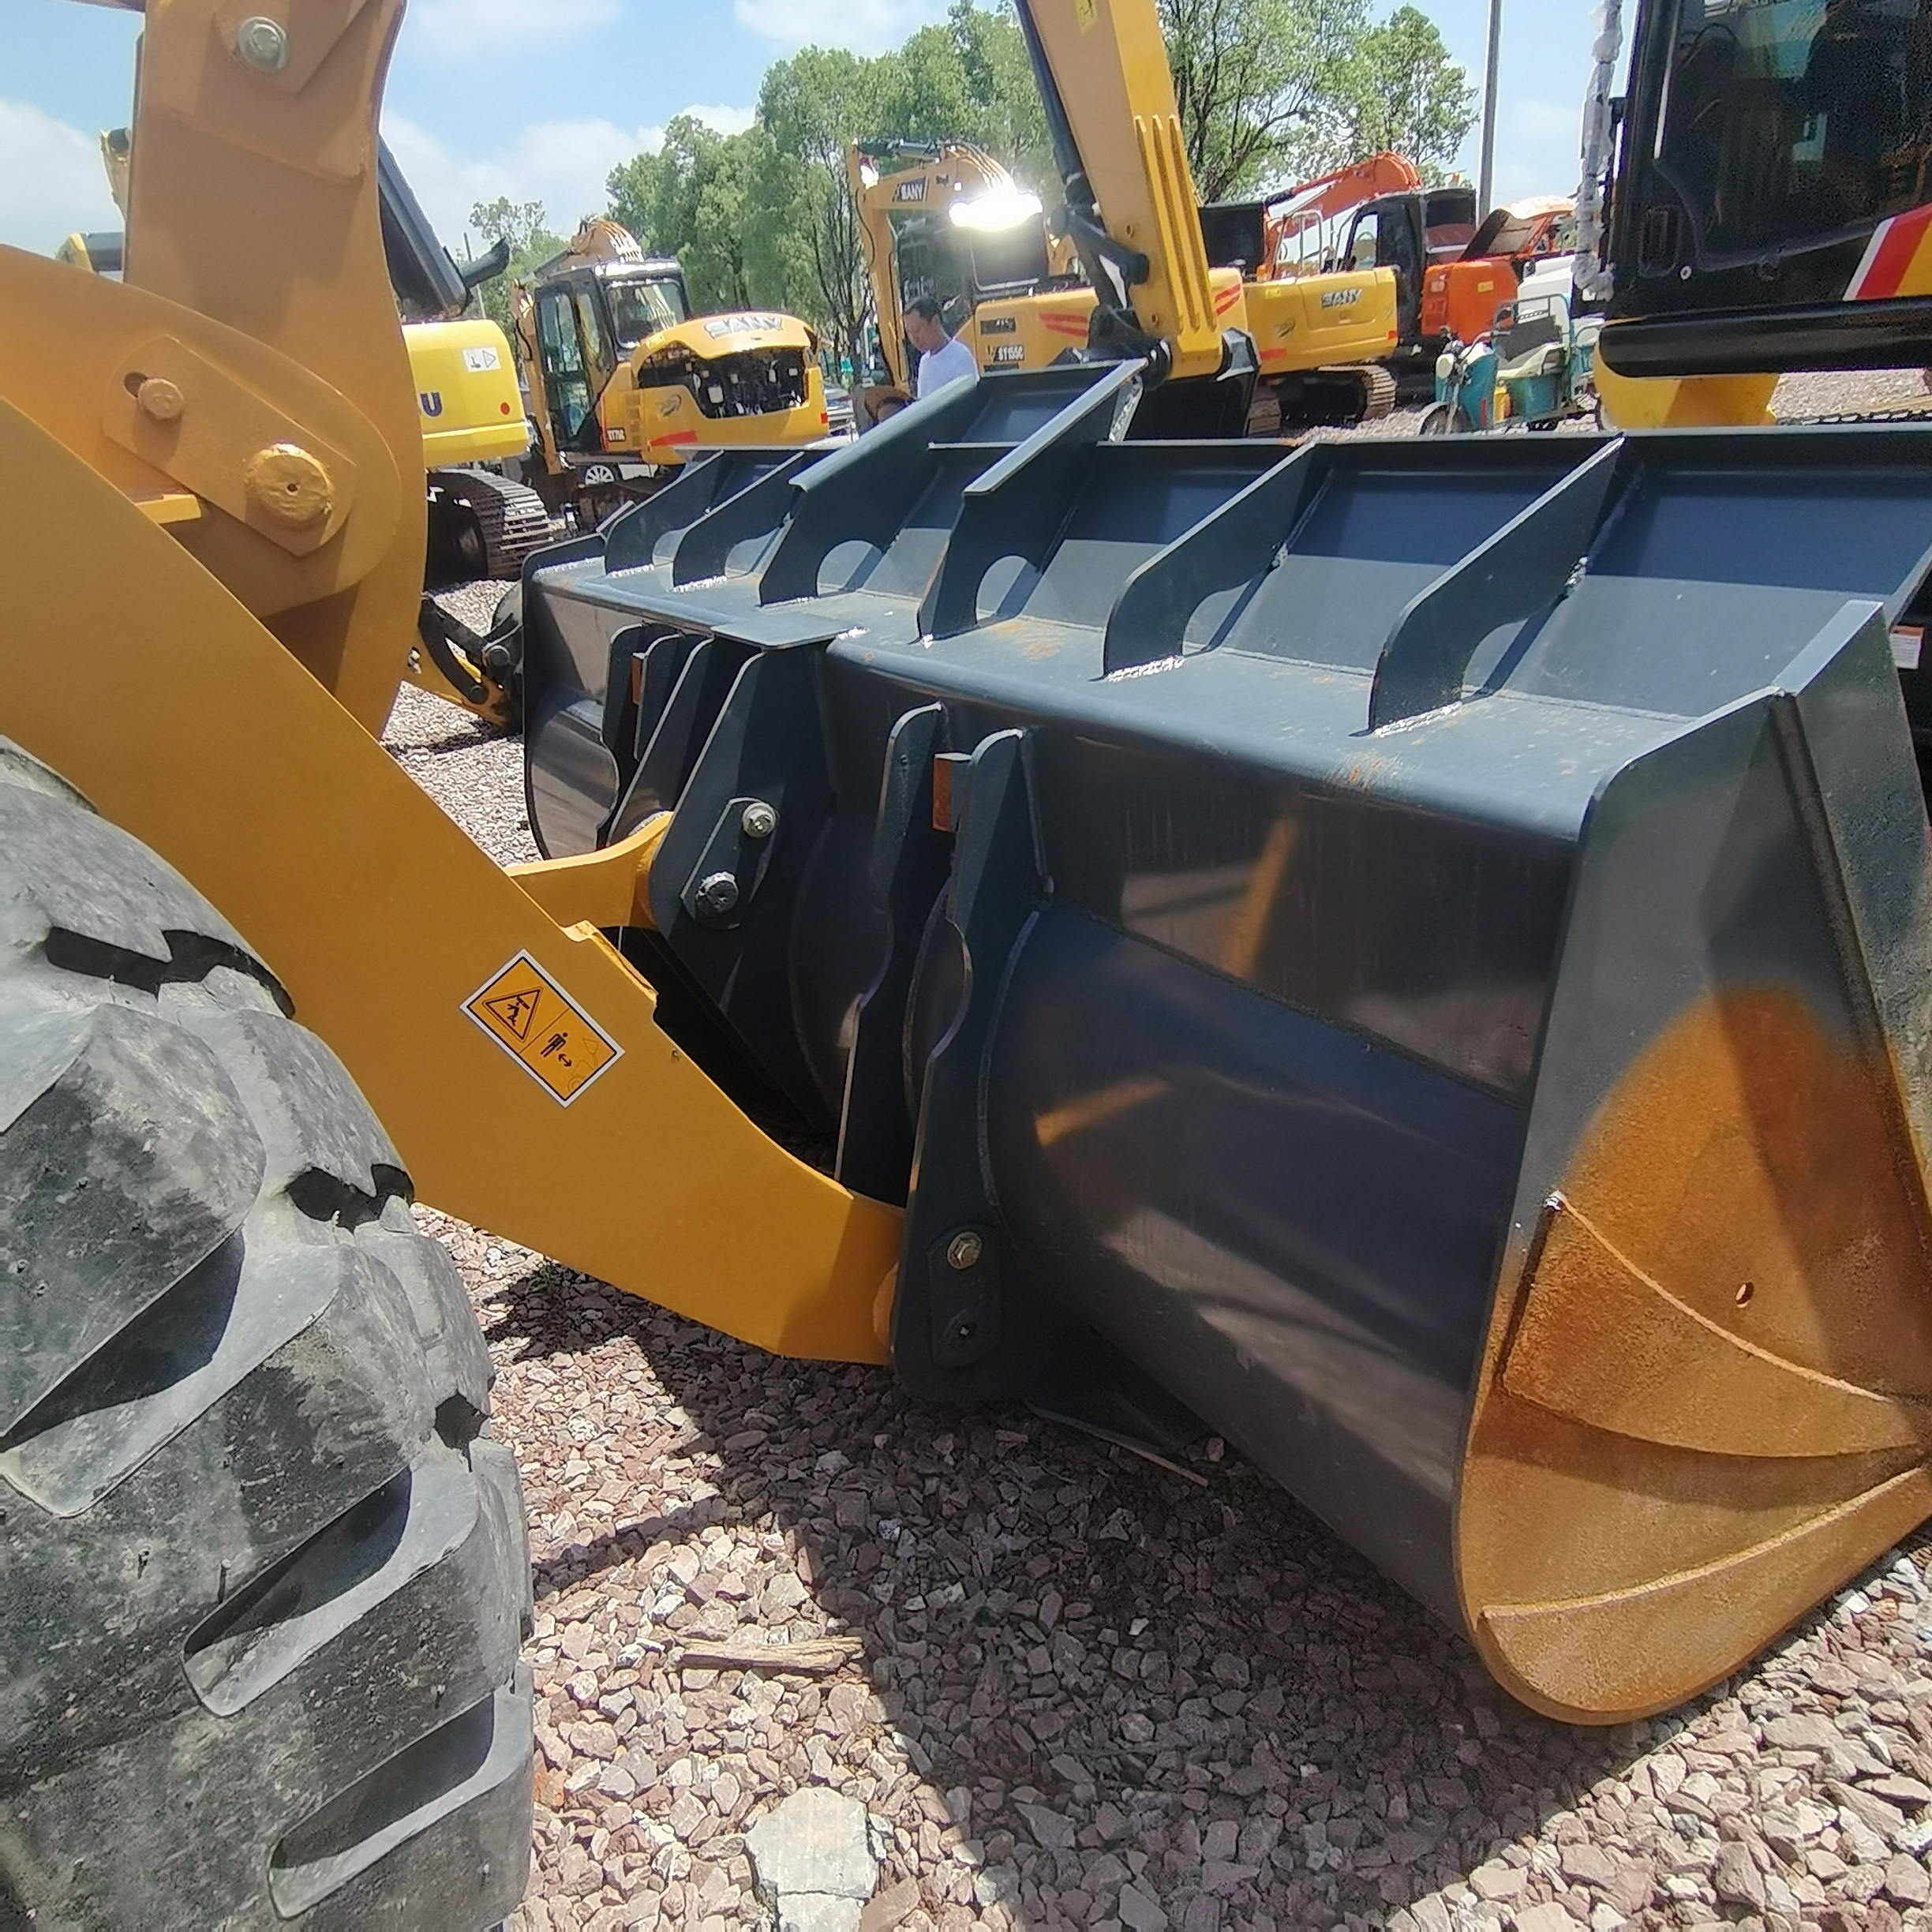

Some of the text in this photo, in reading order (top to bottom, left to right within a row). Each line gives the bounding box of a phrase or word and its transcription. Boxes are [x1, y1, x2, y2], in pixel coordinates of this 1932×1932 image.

[900, 182, 923, 200] SANY
[1322, 288, 1362, 308] SANY
[704, 316, 784, 339] SANY
